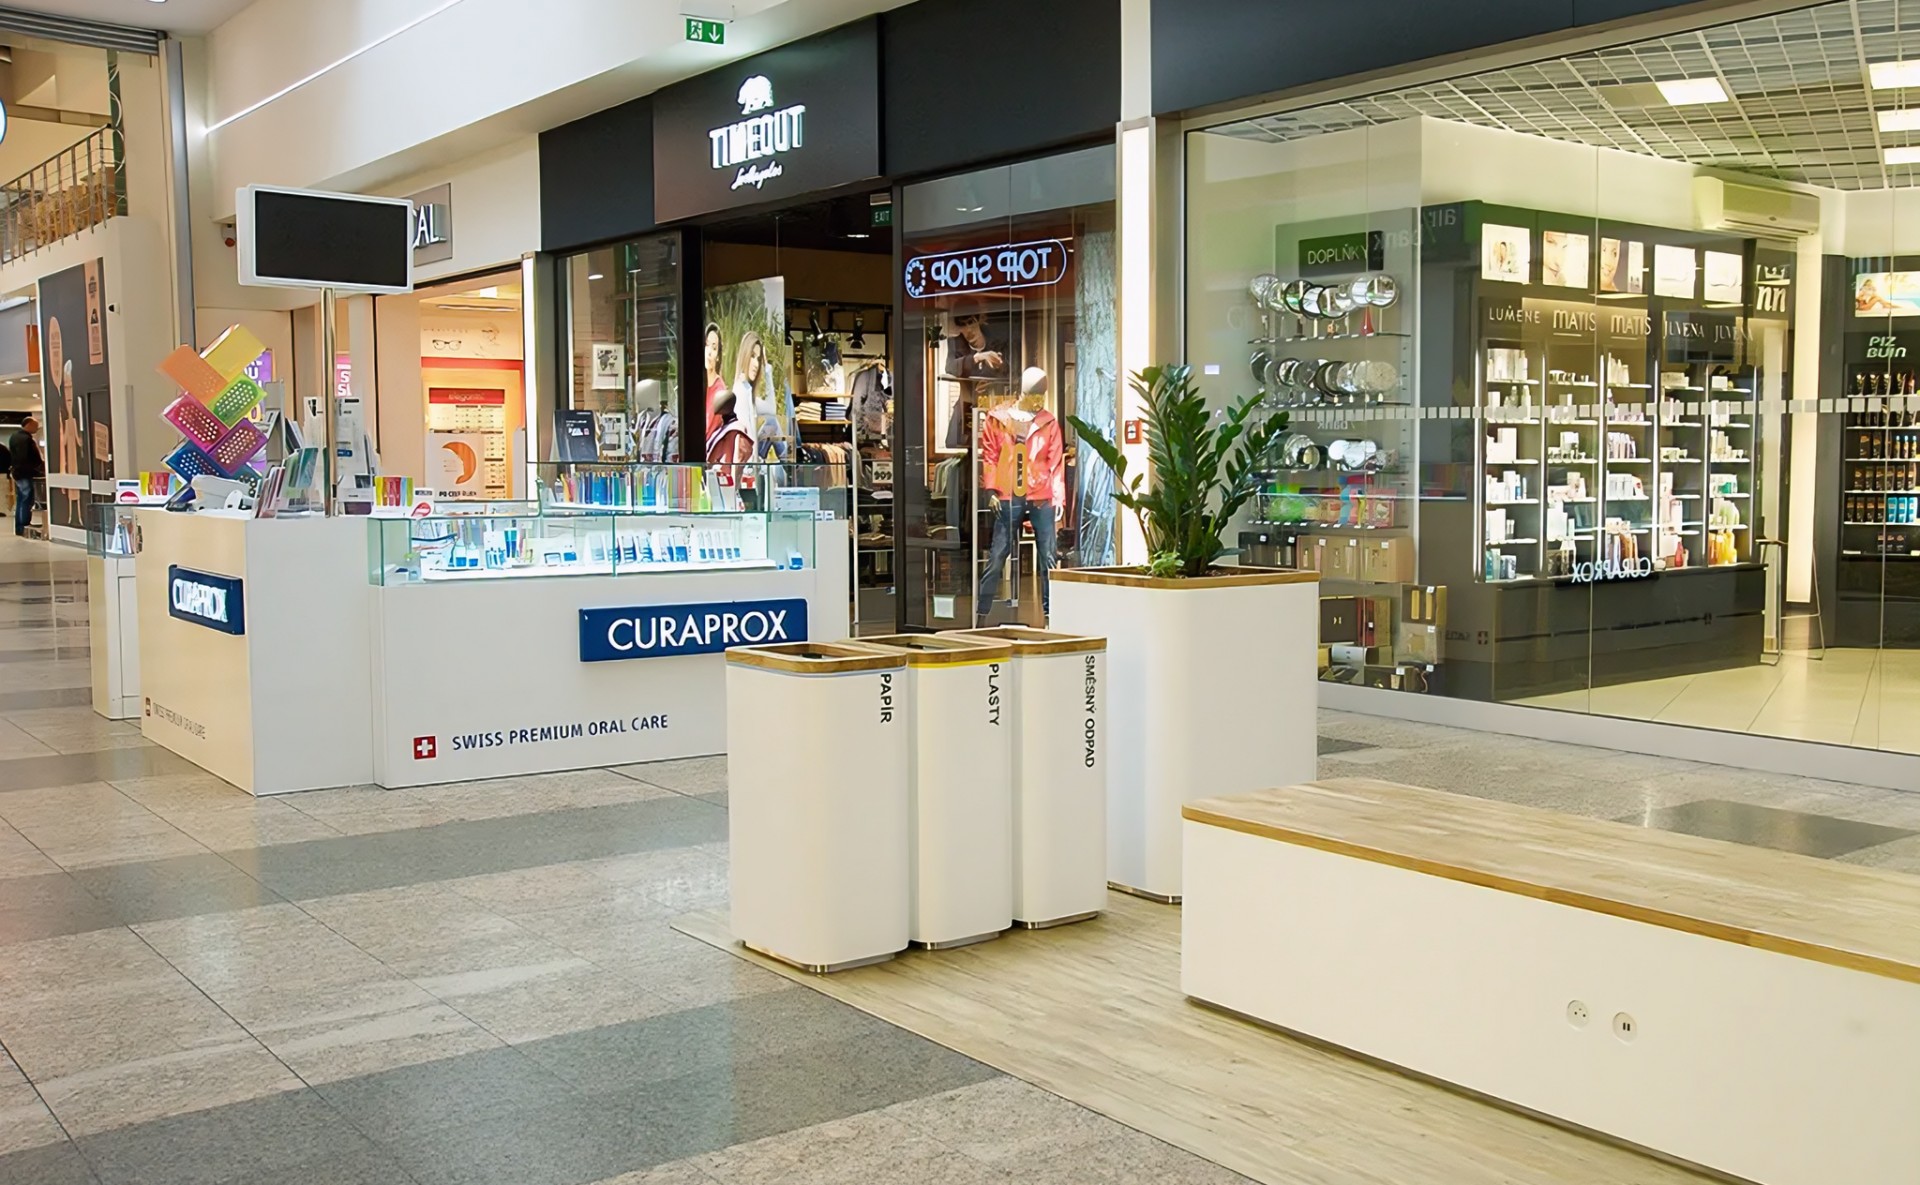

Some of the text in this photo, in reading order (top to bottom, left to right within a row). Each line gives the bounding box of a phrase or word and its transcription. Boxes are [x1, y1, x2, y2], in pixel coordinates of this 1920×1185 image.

[709, 105, 806, 168] TIMEOUT
[874, 210, 890, 222] EXIT
[1610, 315, 1652, 335] MATIS
[1663, 320, 1705, 340] JUVENA
[1868, 335, 1897, 347] PIZ
[608, 609, 788, 651] CURAPROX
[880, 673, 895, 724] PAPÍR
[988, 663, 1001, 726] PLASTY
[1085, 655, 1096, 768] SMĚSNÝ ODPAD
[452, 714, 669, 750] SWISS PREMIUM ORAL CARE
